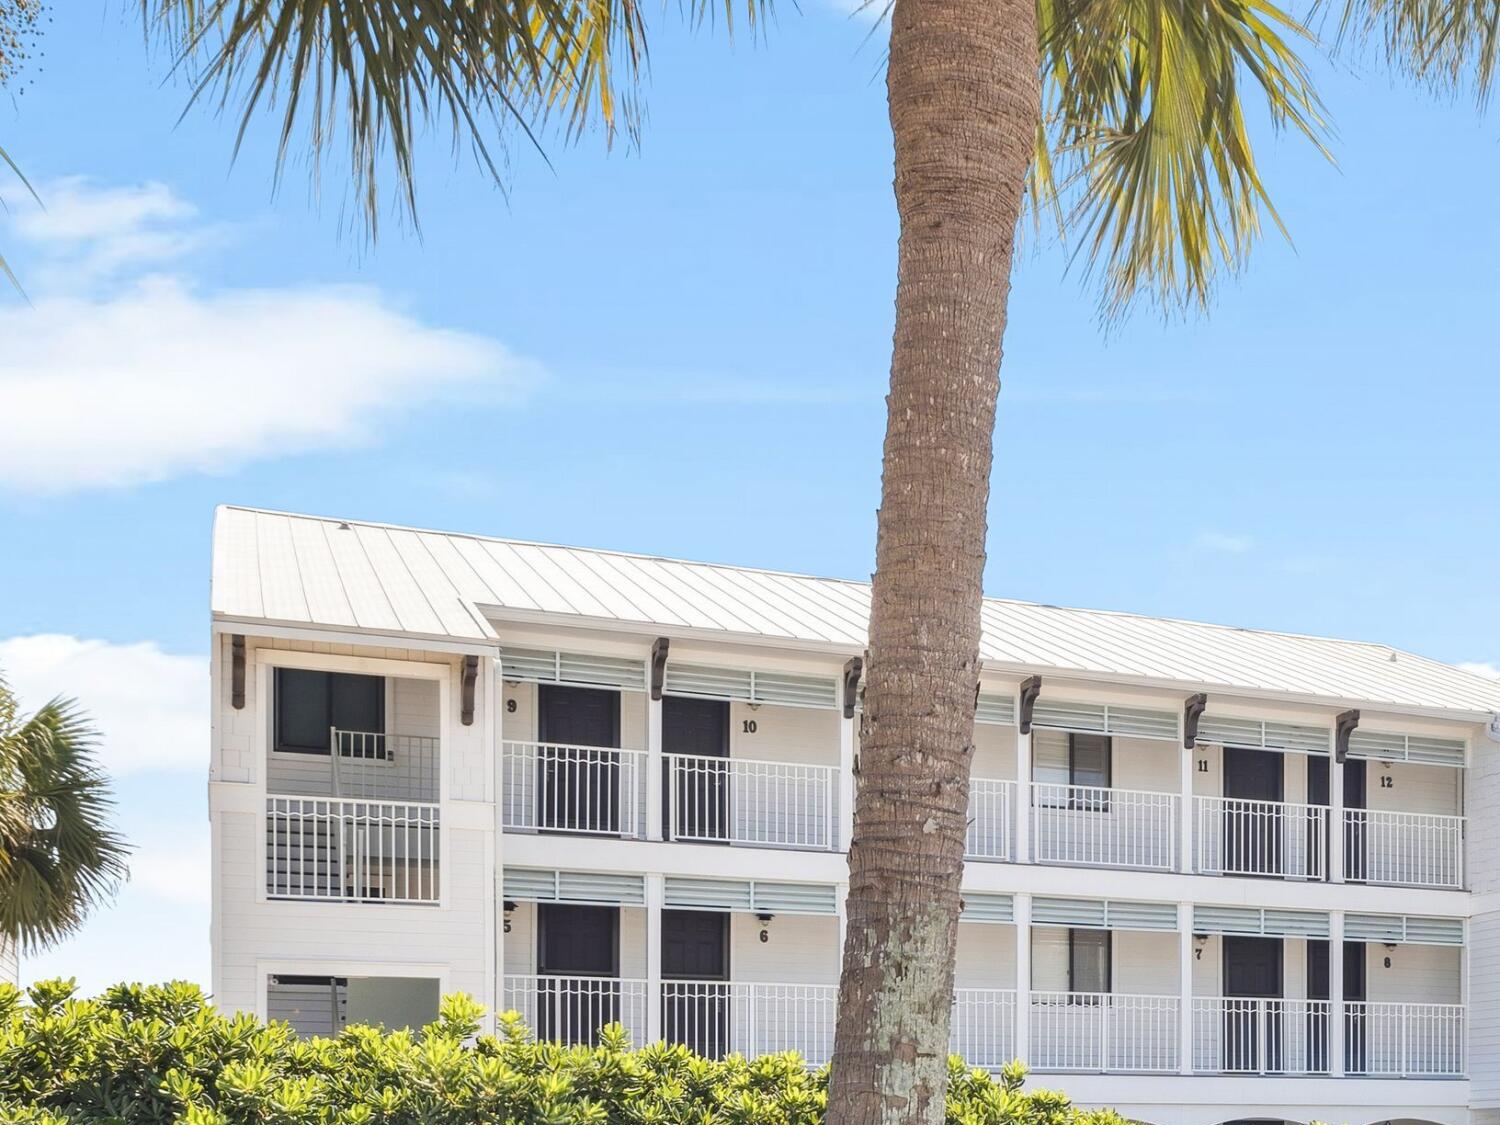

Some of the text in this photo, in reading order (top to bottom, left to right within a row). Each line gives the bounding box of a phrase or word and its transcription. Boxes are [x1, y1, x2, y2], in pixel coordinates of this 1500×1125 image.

[506, 699, 517, 713] 9
[742, 720, 757, 734] 10
[1198, 760, 1209, 773] 11
[1380, 776, 1393, 788] 12
[503, 919, 512, 933] 5
[759, 930, 769, 943] 6
[1195, 949, 1203, 961] 7
[1384, 957, 1391, 969] 8
